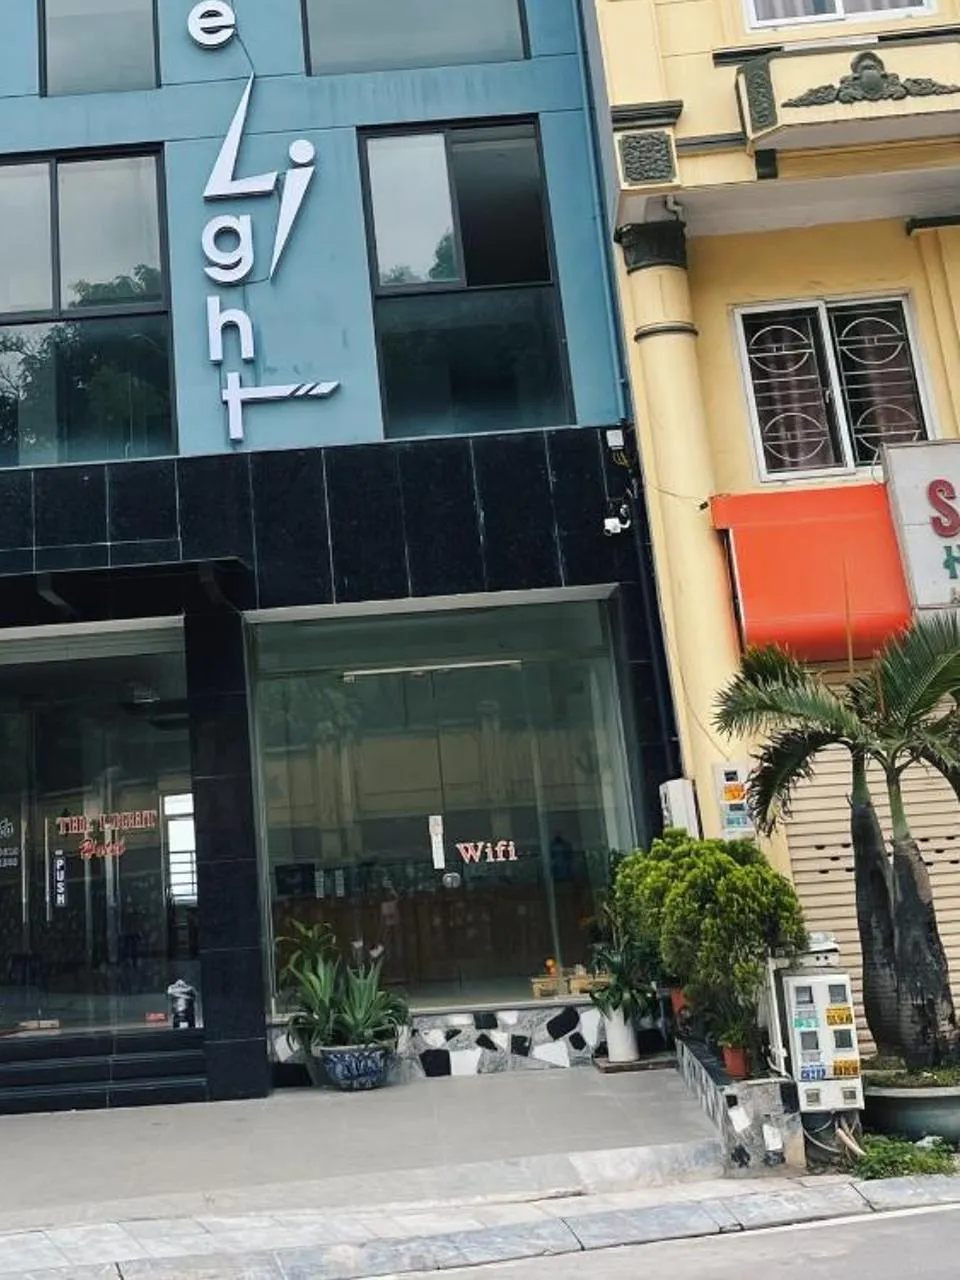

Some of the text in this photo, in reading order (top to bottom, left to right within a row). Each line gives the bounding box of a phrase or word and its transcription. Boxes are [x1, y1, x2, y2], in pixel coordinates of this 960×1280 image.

[201, 70, 342, 443] Light
[455, 840, 518, 864] Wifi
[56, 859, 65, 905] PUSH
